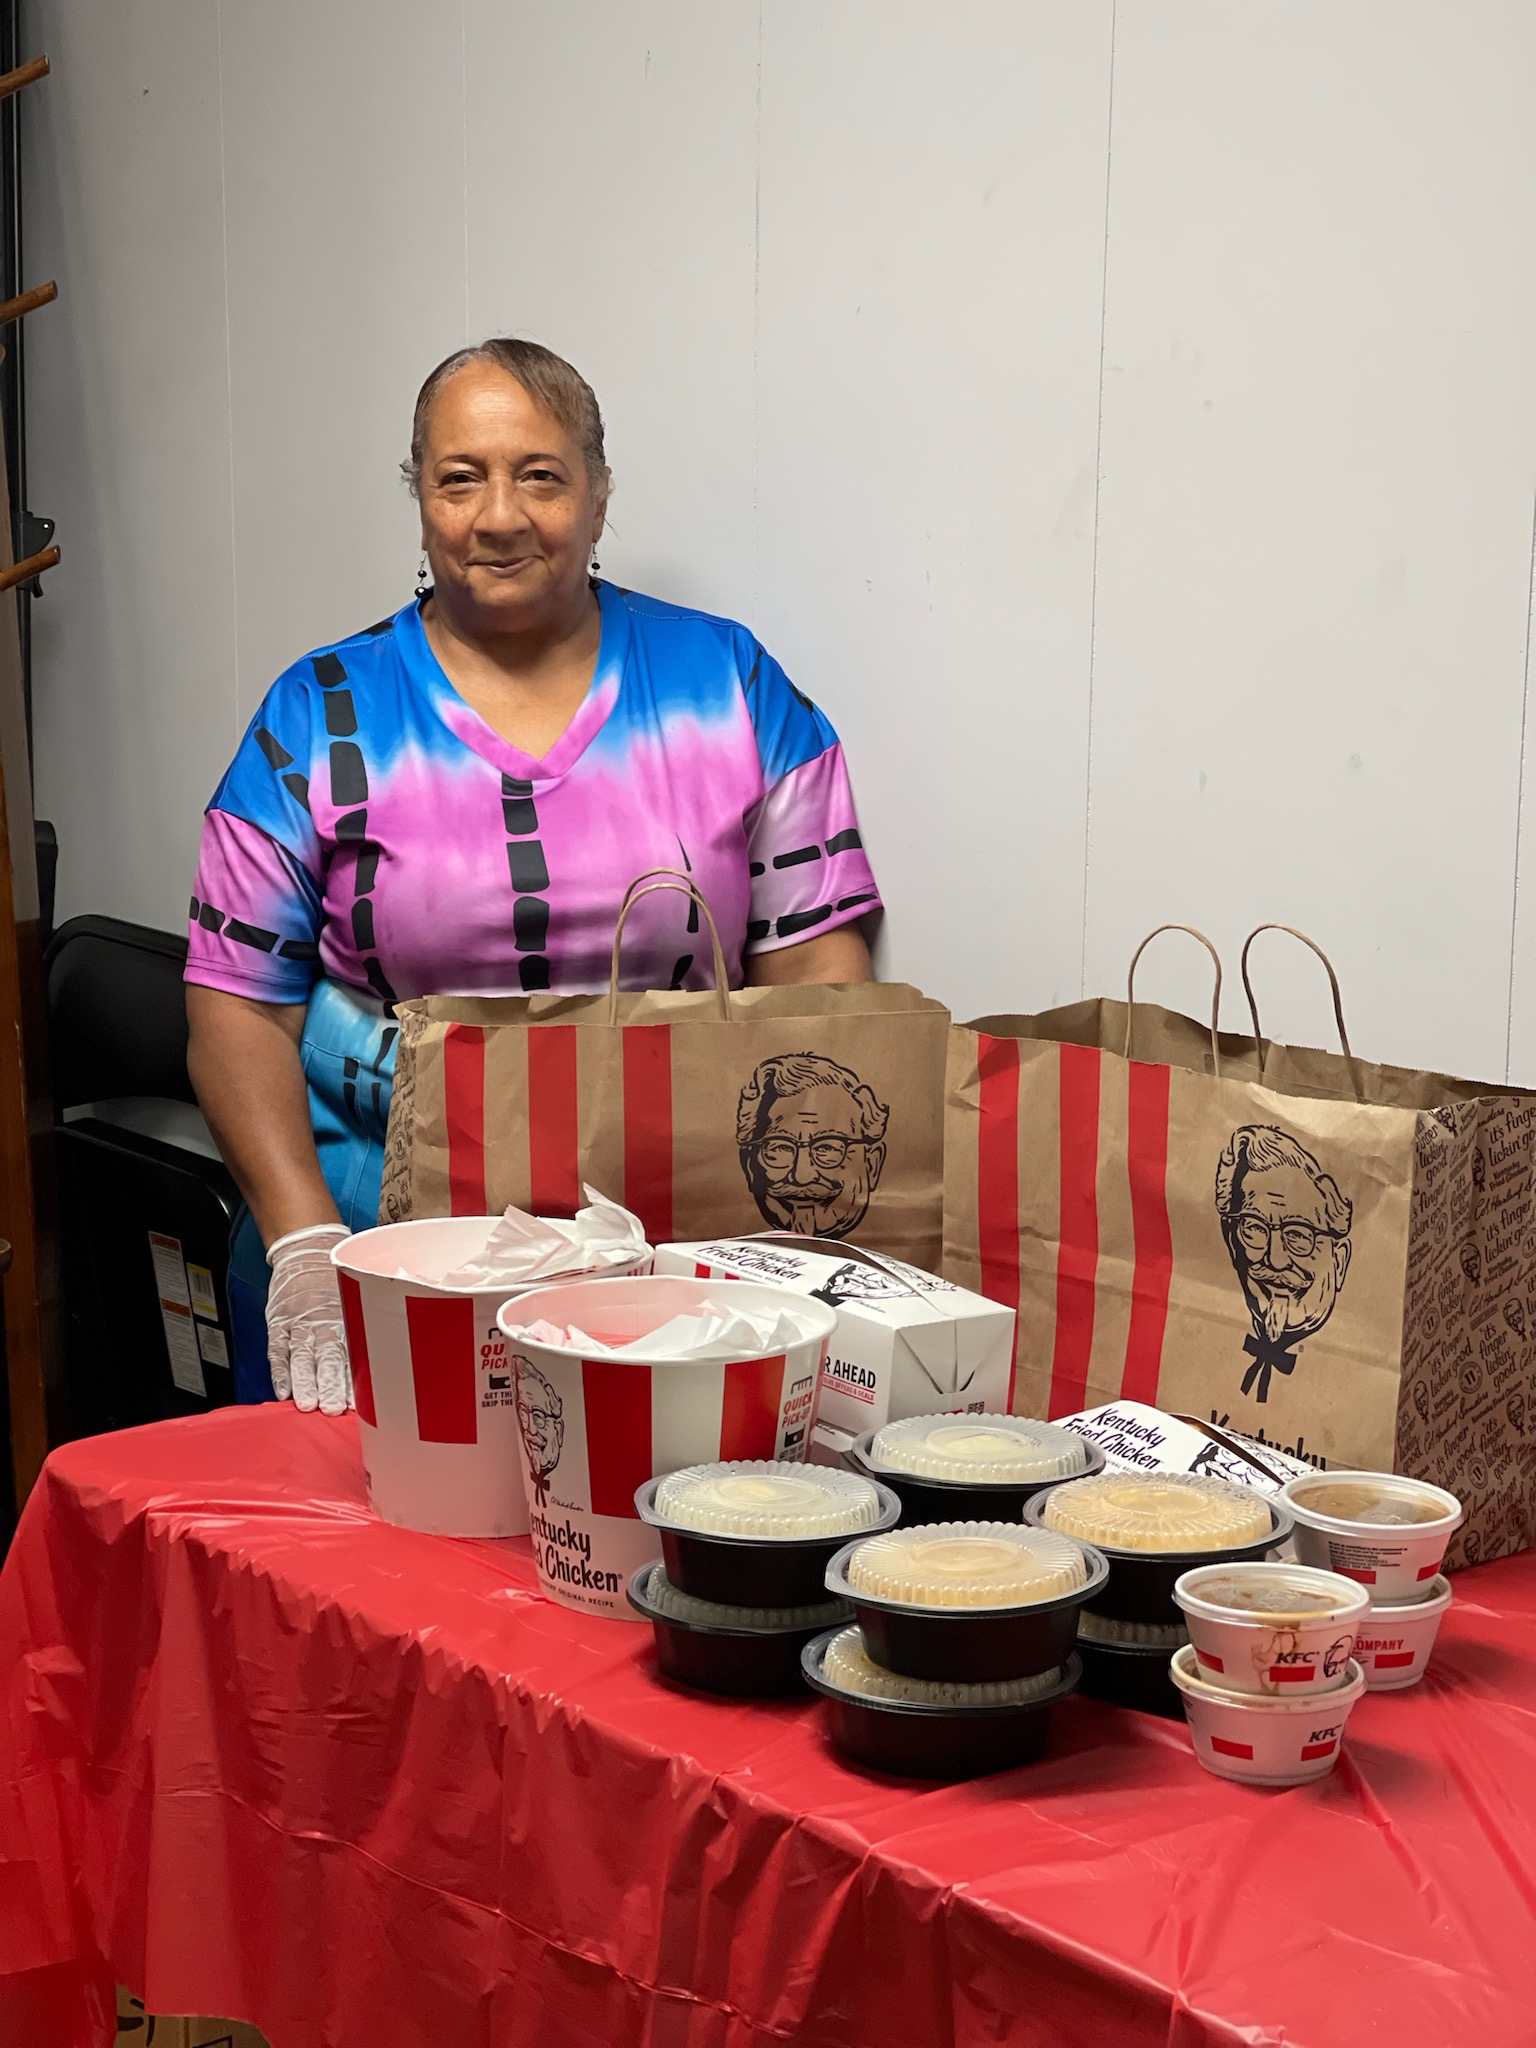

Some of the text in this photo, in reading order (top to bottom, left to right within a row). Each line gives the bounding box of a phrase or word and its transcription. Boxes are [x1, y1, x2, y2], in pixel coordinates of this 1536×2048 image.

[1505, 1108, 1536, 1133] finge
[1500, 1199, 1532, 1230] finger
[697, 1245, 804, 1280] Fried Chicken
[731, 1245, 808, 1268] Kentucky
[1479, 1331, 1507, 1360] finger
[833, 1359, 876, 1389] AHEAD
[481, 1400, 499, 1408] SKIP
[484, 1391, 499, 1400] GET
[783, 1391, 813, 1416] QUICK
[1090, 1408, 1167, 1450] Kentucky
[1062, 1417, 1161, 1470] Fried Chicken
[530, 1512, 591, 1563] entucky
[588, 1597, 615, 1609] RECIPE
[1275, 1651, 1316, 1664] KFC
[1353, 1639, 1404, 1651] OMPANY
[1308, 1725, 1342, 1742] KFC
